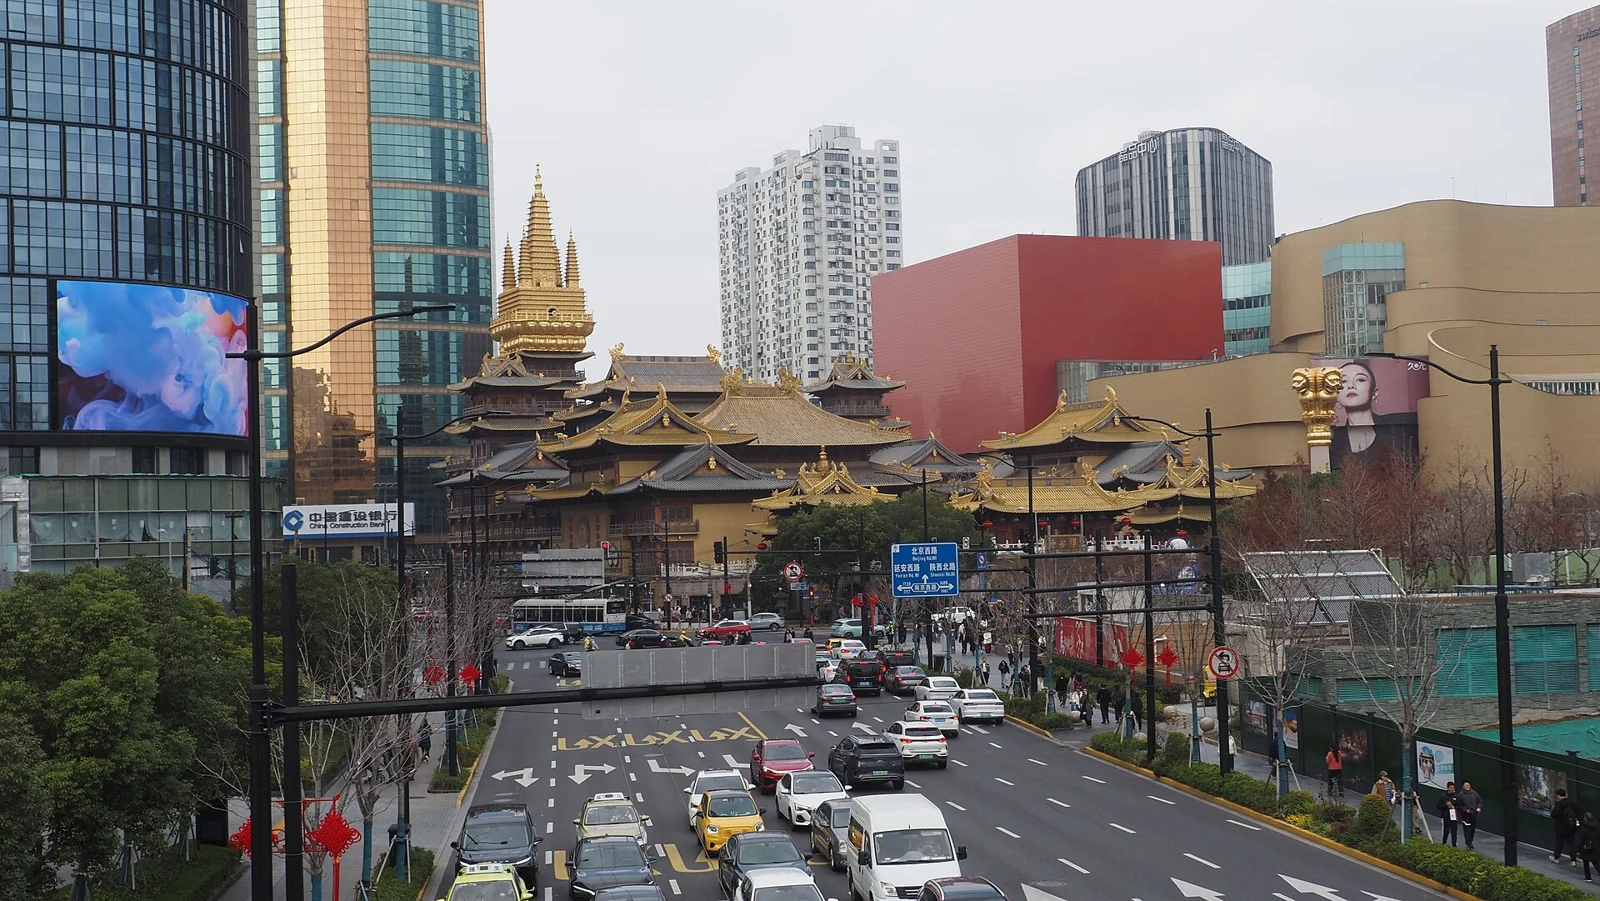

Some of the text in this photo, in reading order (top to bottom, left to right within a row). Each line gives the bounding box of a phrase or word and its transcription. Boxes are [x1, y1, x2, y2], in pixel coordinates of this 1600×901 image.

[309, 510, 397, 523] 中国建设银行
[330, 521, 369, 529] Construction
[911, 546, 938, 555] 北京西路
[894, 563, 920, 572] 延安西路
[929, 562, 956, 571] 陕西北路
